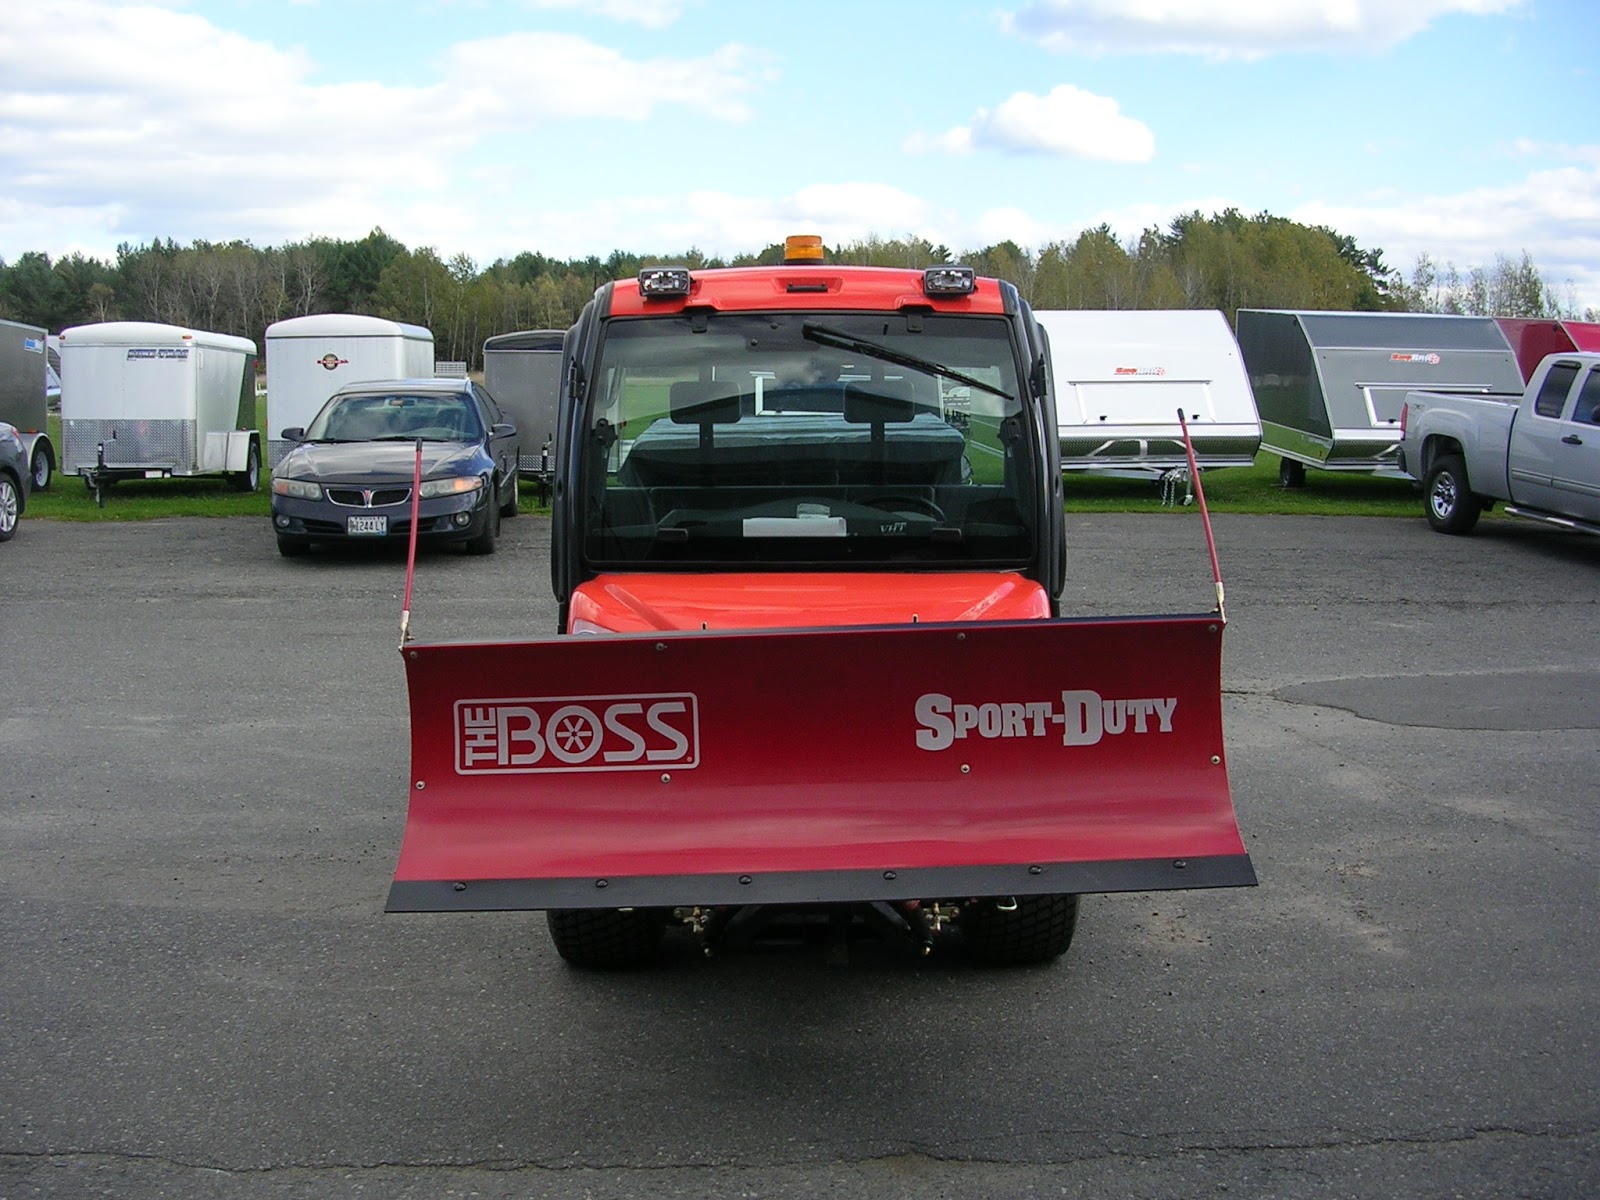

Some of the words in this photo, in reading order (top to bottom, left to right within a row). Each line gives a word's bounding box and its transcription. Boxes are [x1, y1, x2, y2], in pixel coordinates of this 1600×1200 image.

[464, 707, 498, 766] THE
[497, 701, 689, 765] BOSS
[914, 689, 1178, 751] SPORT-DUTY
